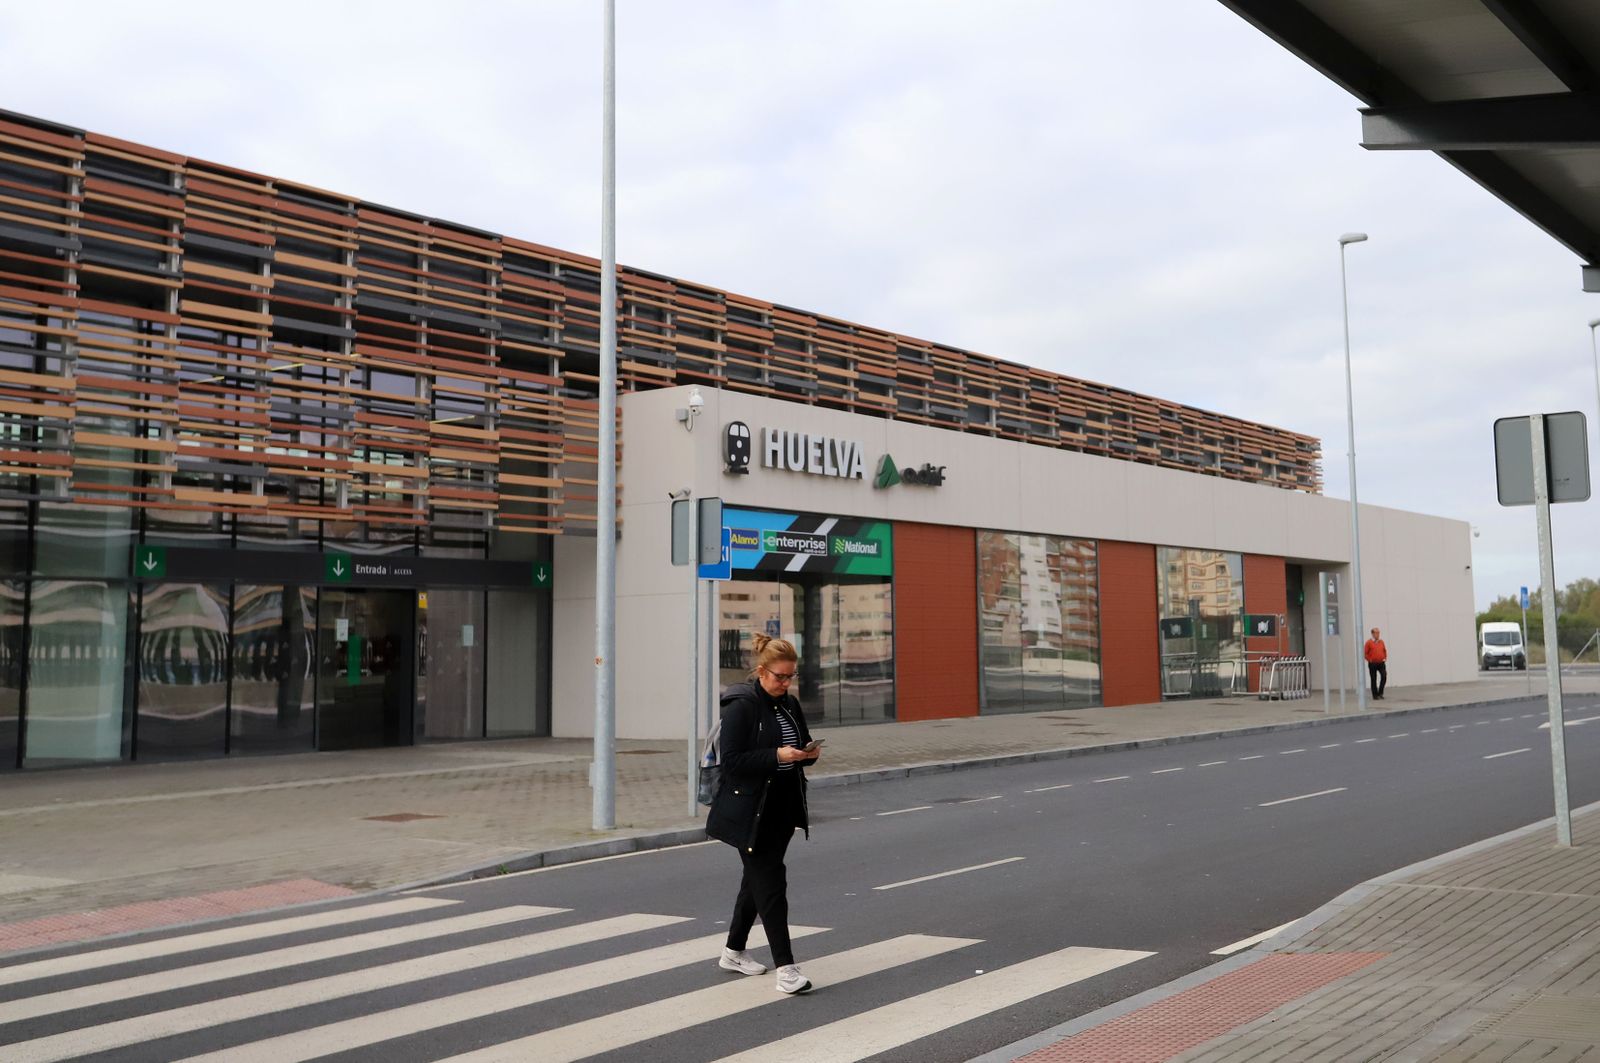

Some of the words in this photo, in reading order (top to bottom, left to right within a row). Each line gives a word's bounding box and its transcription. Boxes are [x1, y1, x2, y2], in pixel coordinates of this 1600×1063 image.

[761, 427, 867, 480] HUELVA
[731, 533, 759, 546] Alamo
[767, 536, 826, 551] enterprise
[844, 540, 878, 555] National
[355, 564, 387, 575] Entrada
